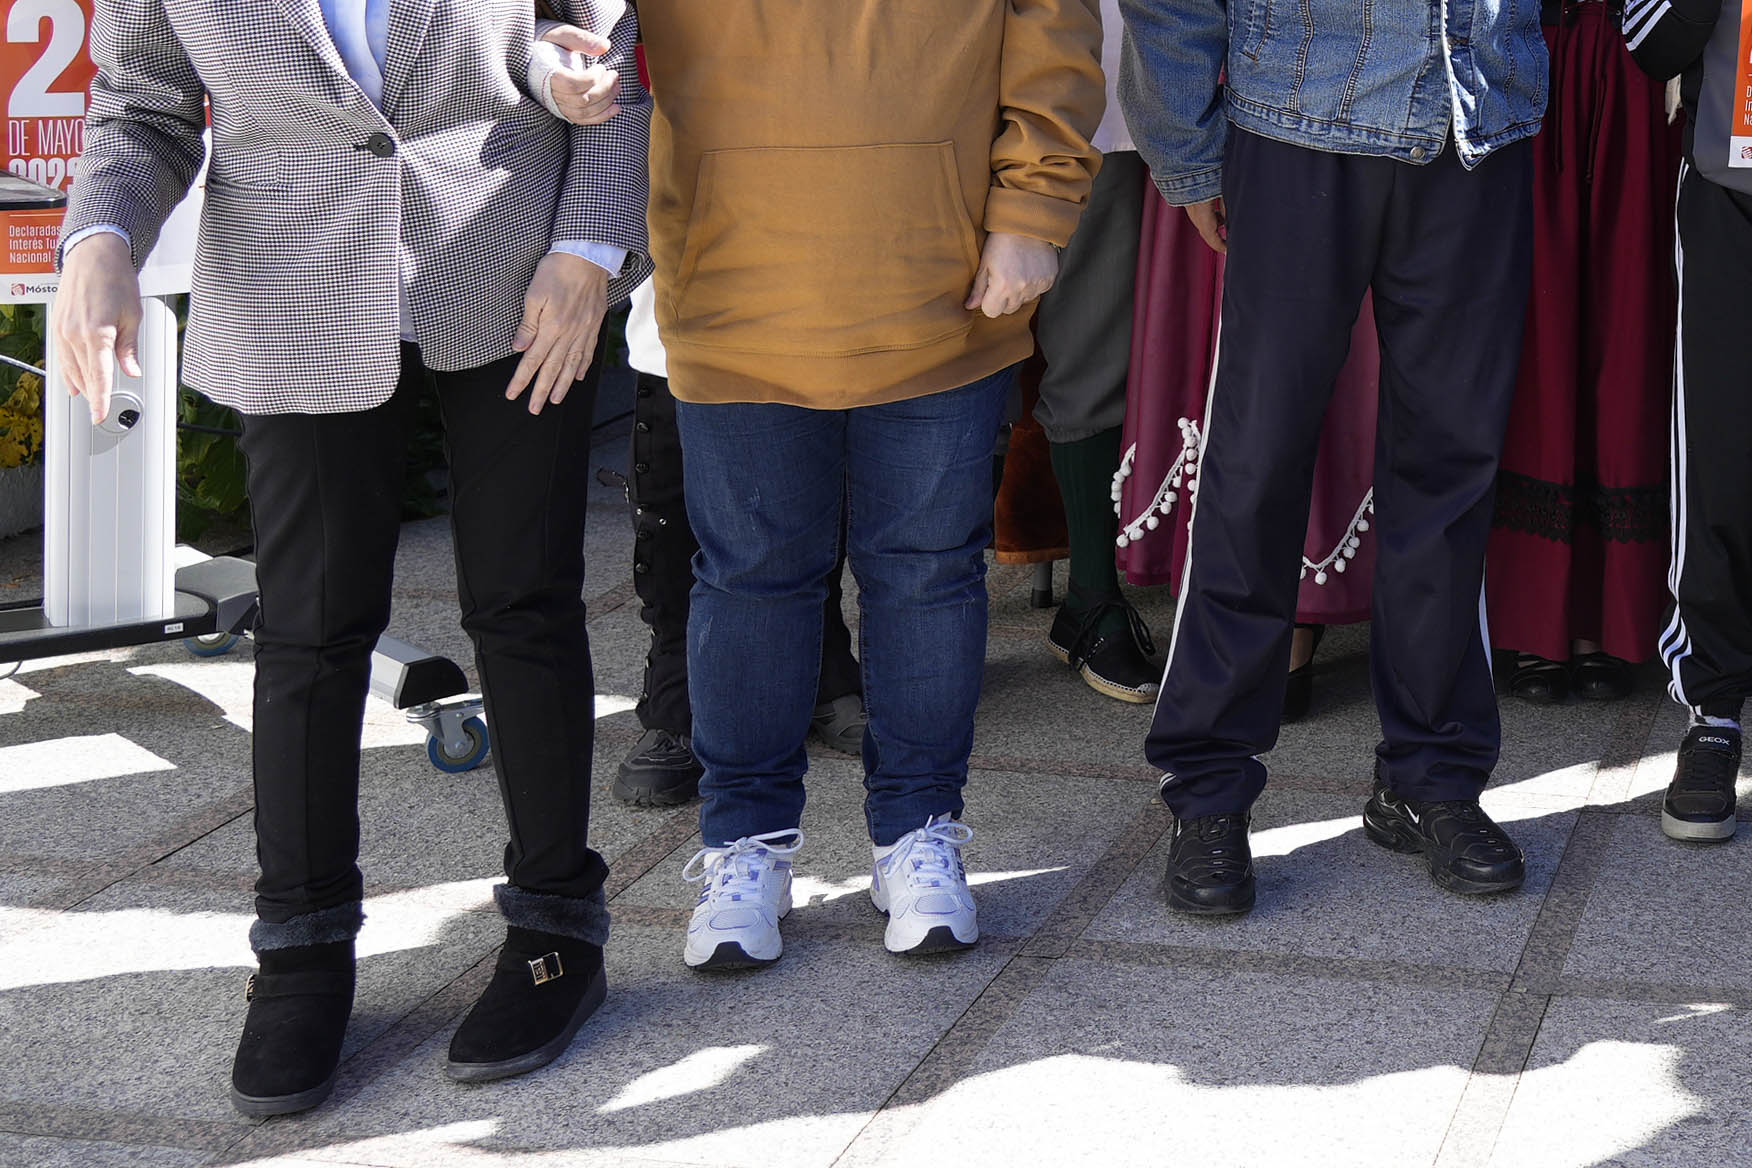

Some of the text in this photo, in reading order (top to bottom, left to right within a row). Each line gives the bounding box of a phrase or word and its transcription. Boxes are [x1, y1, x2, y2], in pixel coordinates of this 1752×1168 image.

[9, 118, 86, 156] DE MAYO
[9, 224, 62, 237] Declaradas
[9, 237, 44, 250] Interés
[9, 251, 52, 264] Nacional
[26, 284, 58, 293] Mósto
[1698, 736, 1730, 746] GEOX
